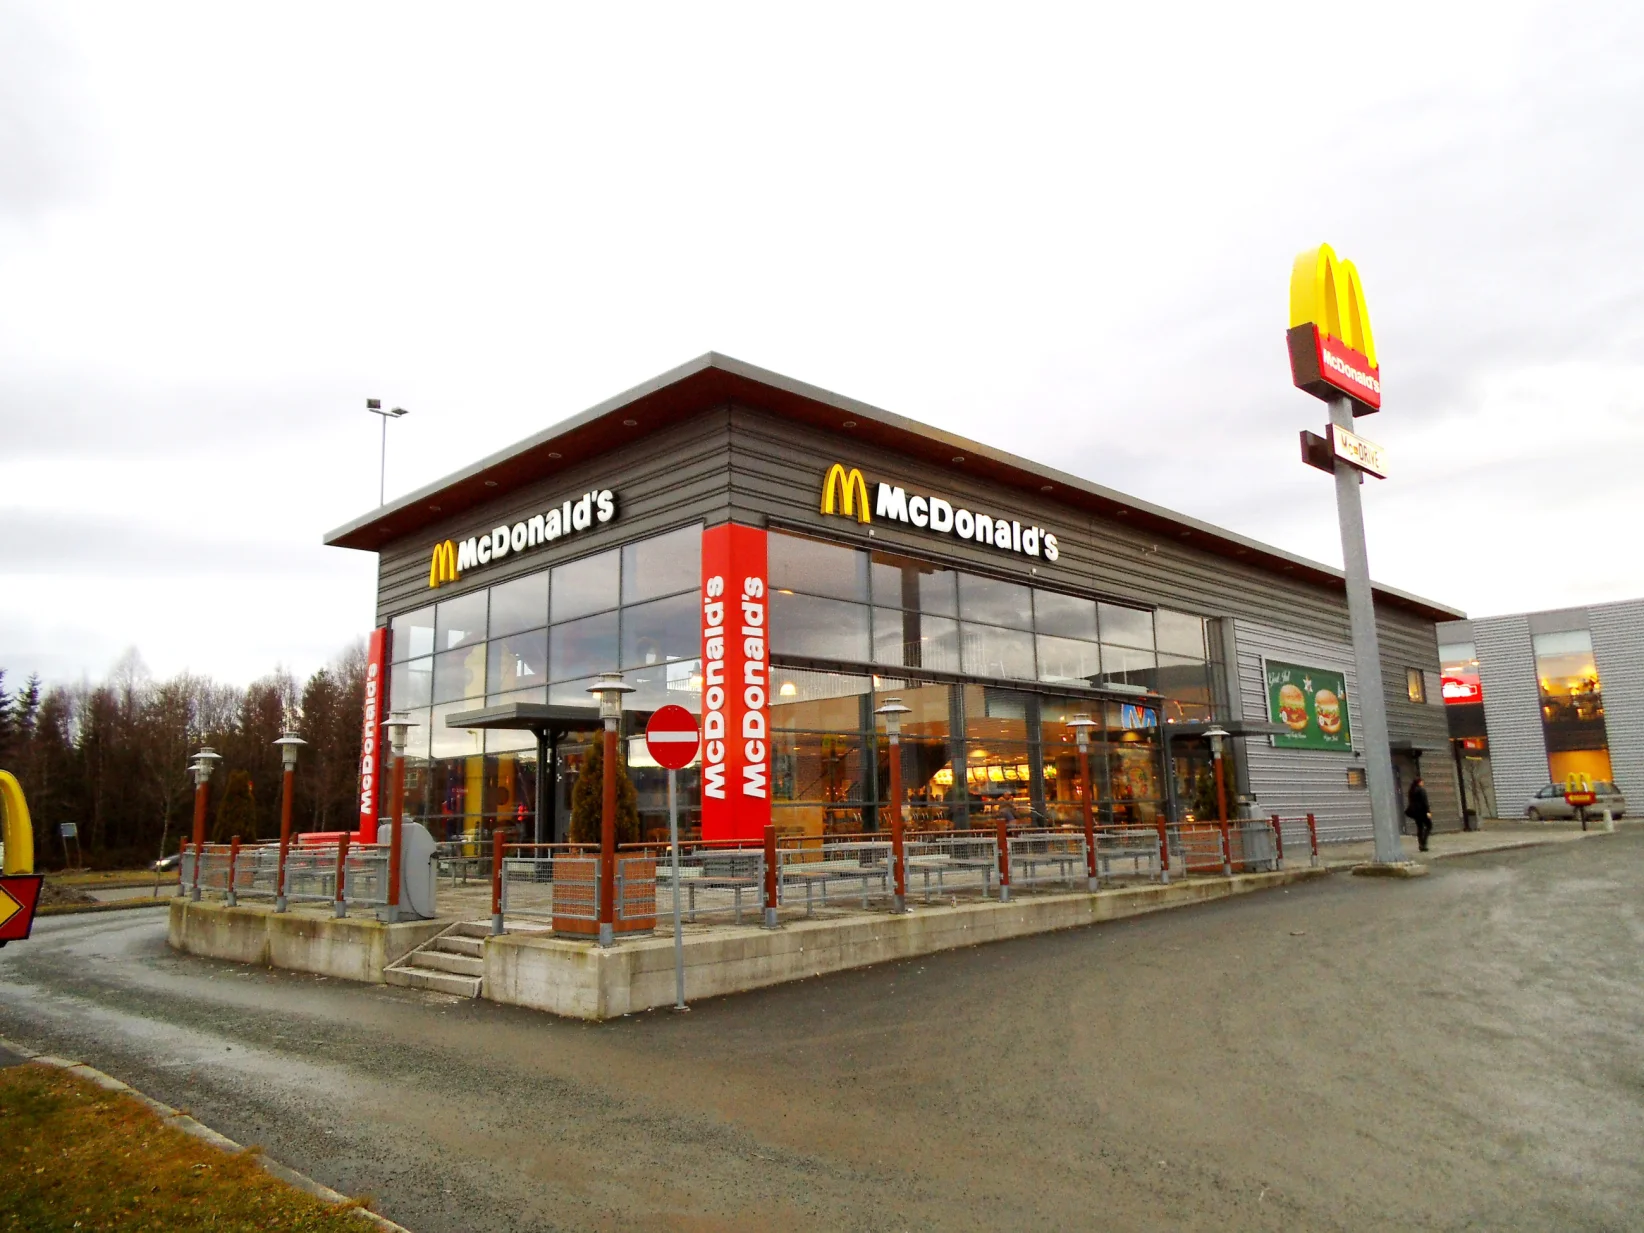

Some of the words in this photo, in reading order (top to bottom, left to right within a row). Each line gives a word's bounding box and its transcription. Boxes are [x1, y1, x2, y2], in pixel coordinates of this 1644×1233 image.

[1323, 348, 1380, 393] McDonald's
[456, 489, 615, 572] McDonald's
[875, 482, 1059, 562] McDonald's
[360, 663, 378, 815] McDonald's
[704, 575, 726, 800] McDonald's
[741, 576, 766, 799] McDonald's
